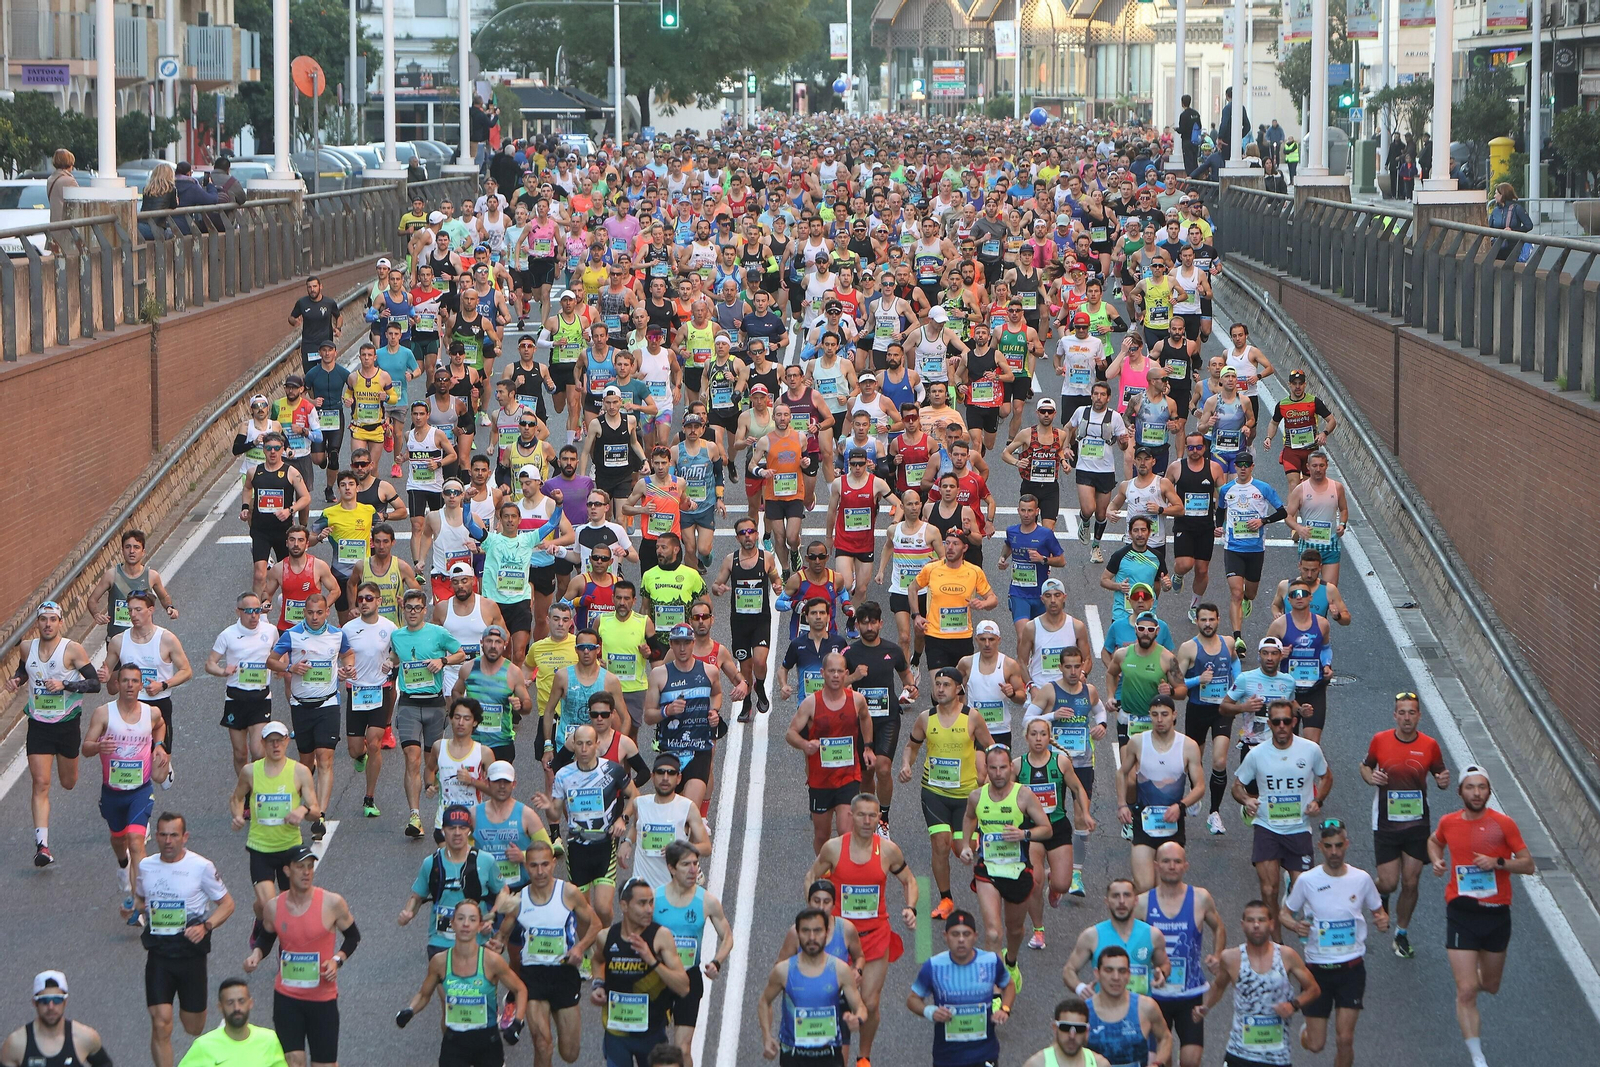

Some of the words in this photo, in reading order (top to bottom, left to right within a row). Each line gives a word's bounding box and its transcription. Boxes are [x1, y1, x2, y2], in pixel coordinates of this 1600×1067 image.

[412, 451, 429, 459] ASM
[120, 761, 142, 769] ZURICH
[450, 811, 469, 821] OTSO
[498, 832, 519, 841] ULSA
[959, 1006, 981, 1014] ZURICH
